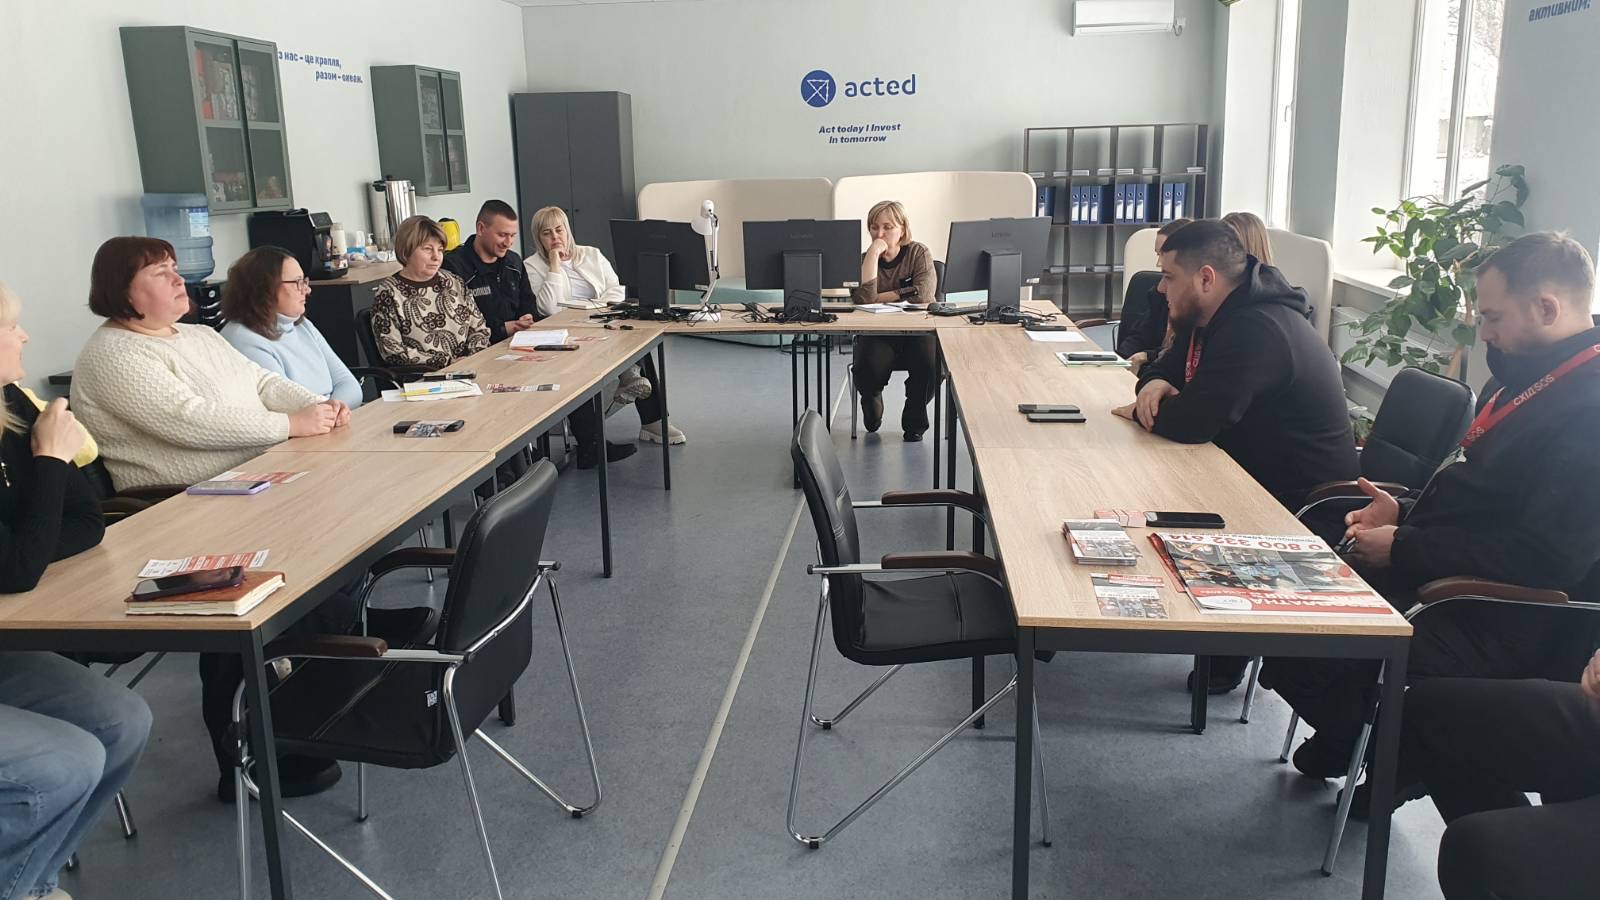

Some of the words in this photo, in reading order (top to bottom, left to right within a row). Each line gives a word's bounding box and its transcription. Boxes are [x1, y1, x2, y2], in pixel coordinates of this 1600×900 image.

[284, 51, 299, 62] нас
[304, 53, 314, 65] це
[315, 56, 342, 70] крапля,
[315, 71, 337, 82] разом
[844, 73, 916, 98] acted
[818, 125, 835, 134] Act
[837, 124, 865, 134] today
[840, 134, 887, 144] tomorrow
[1258, 540, 1301, 551] 800
